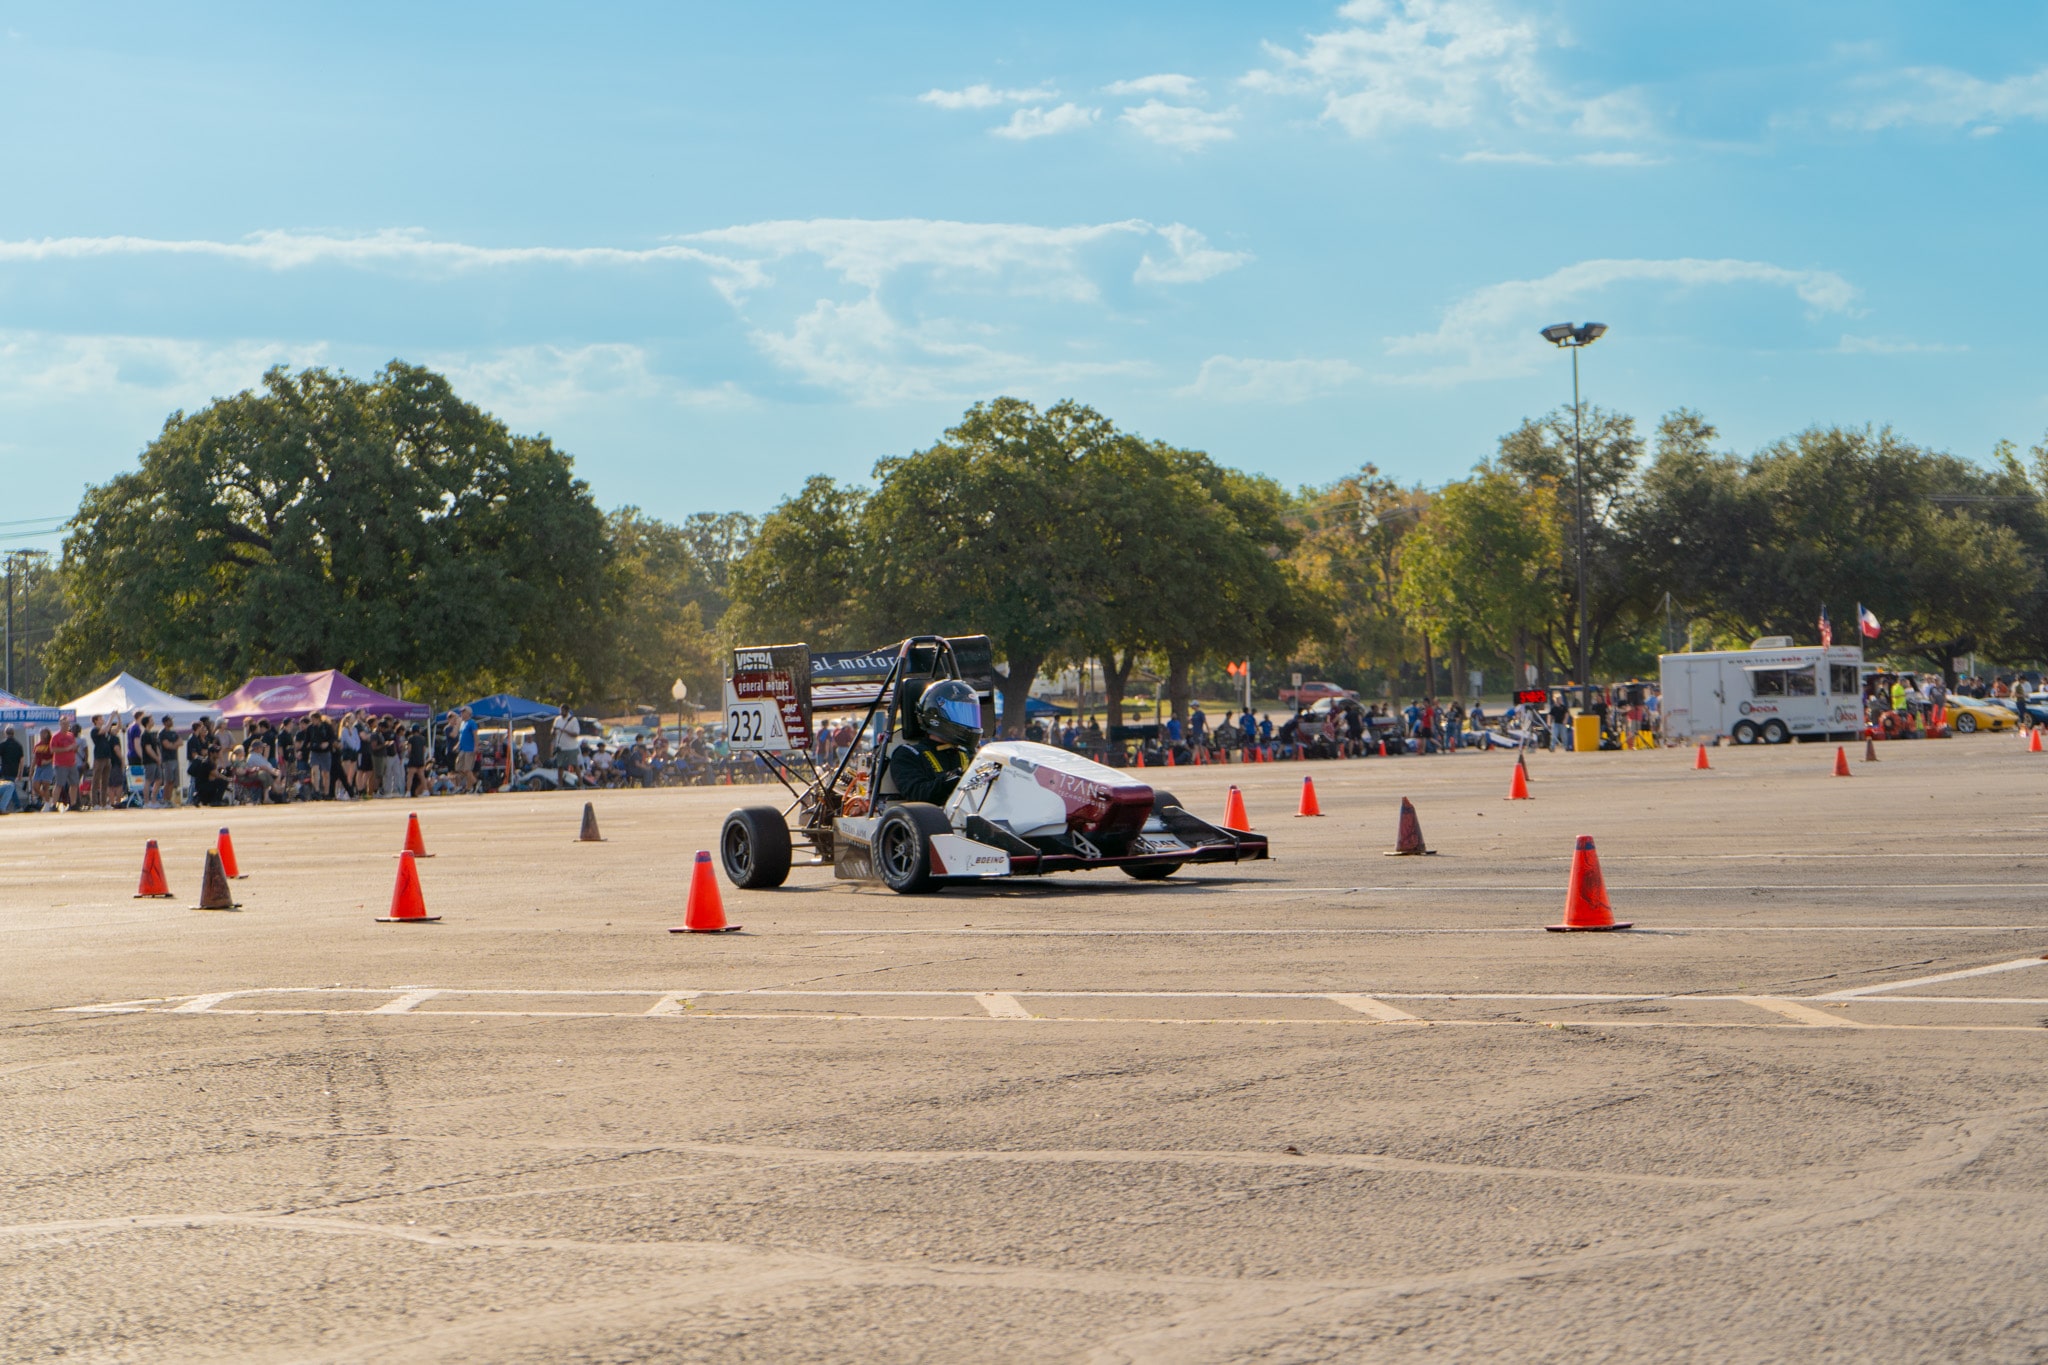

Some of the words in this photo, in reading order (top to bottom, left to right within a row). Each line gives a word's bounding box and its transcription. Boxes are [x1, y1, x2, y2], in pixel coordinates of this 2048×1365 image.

[735, 652, 774, 670] VISTRA
[838, 655, 896, 670] motor
[738, 679, 764, 695] general
[765, 680, 790, 691] motors
[3, 709, 18, 720] OILS
[26, 709, 60, 720] ADDITIVES
[731, 709, 763, 741] 232
[1059, 772, 1108, 801] TRANE
[976, 856, 1005, 864] BOEING
